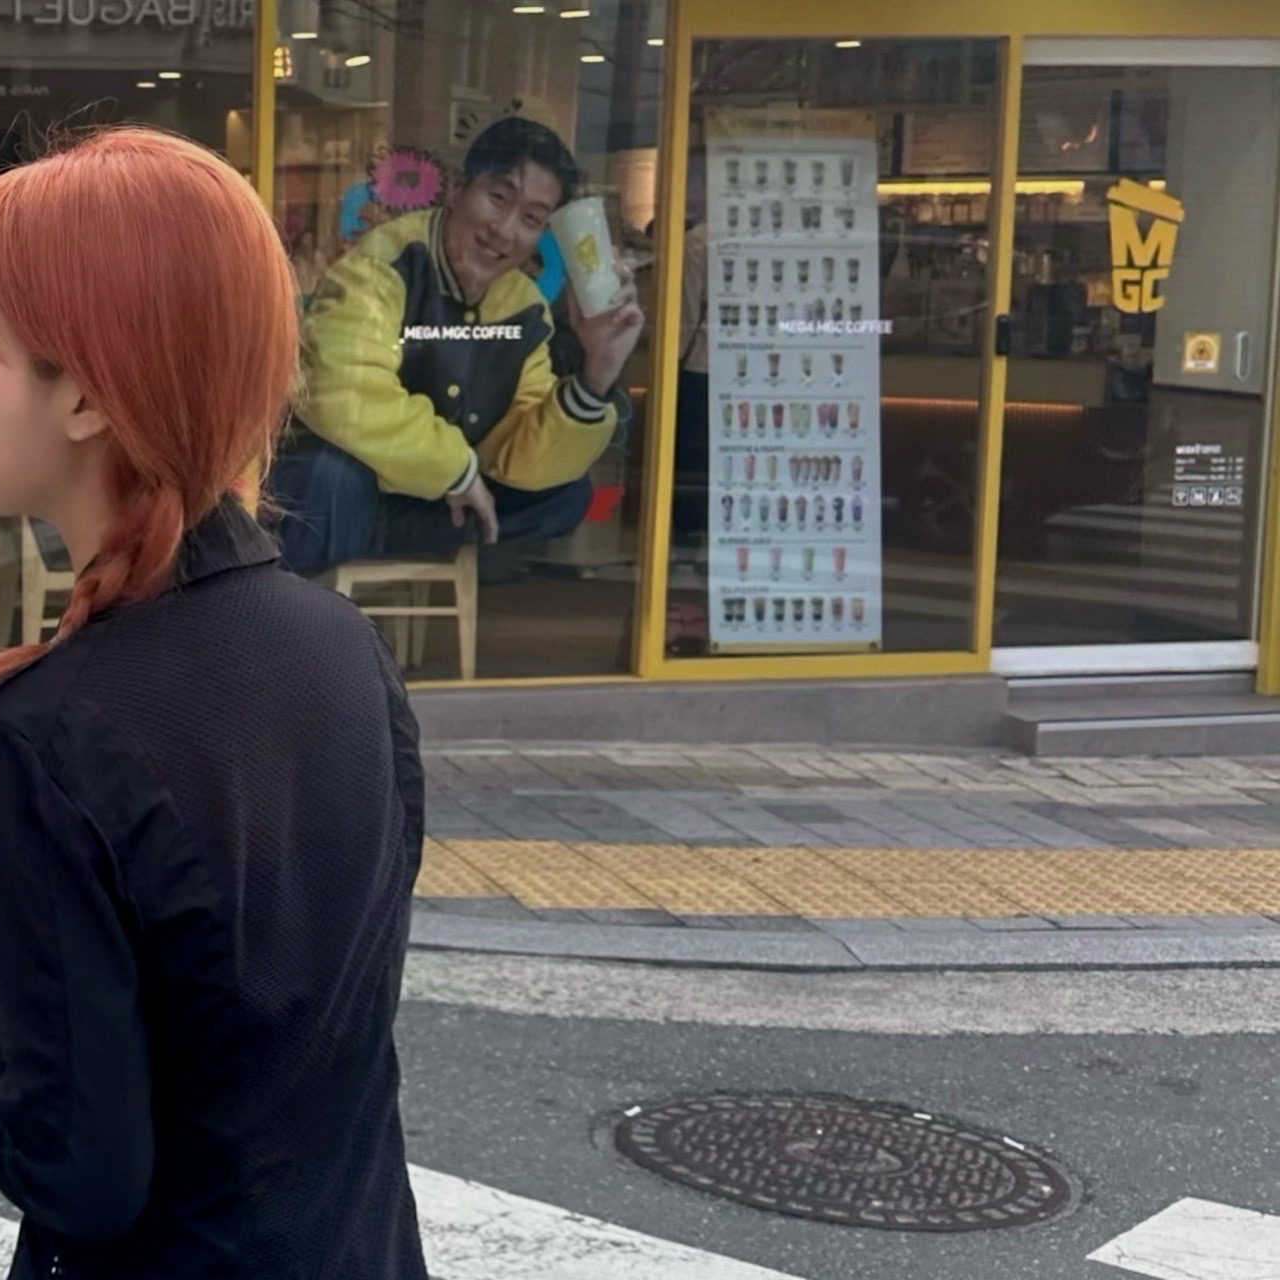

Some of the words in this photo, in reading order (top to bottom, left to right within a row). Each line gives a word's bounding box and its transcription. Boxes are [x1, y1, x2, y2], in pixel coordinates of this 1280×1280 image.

[404, 325, 440, 340] MEGA
[441, 325, 471, 340] MGC
[472, 325, 522, 340] COFFEE
[780, 320, 815, 334] MEGA
[845, 320, 893, 335] COFFEE
